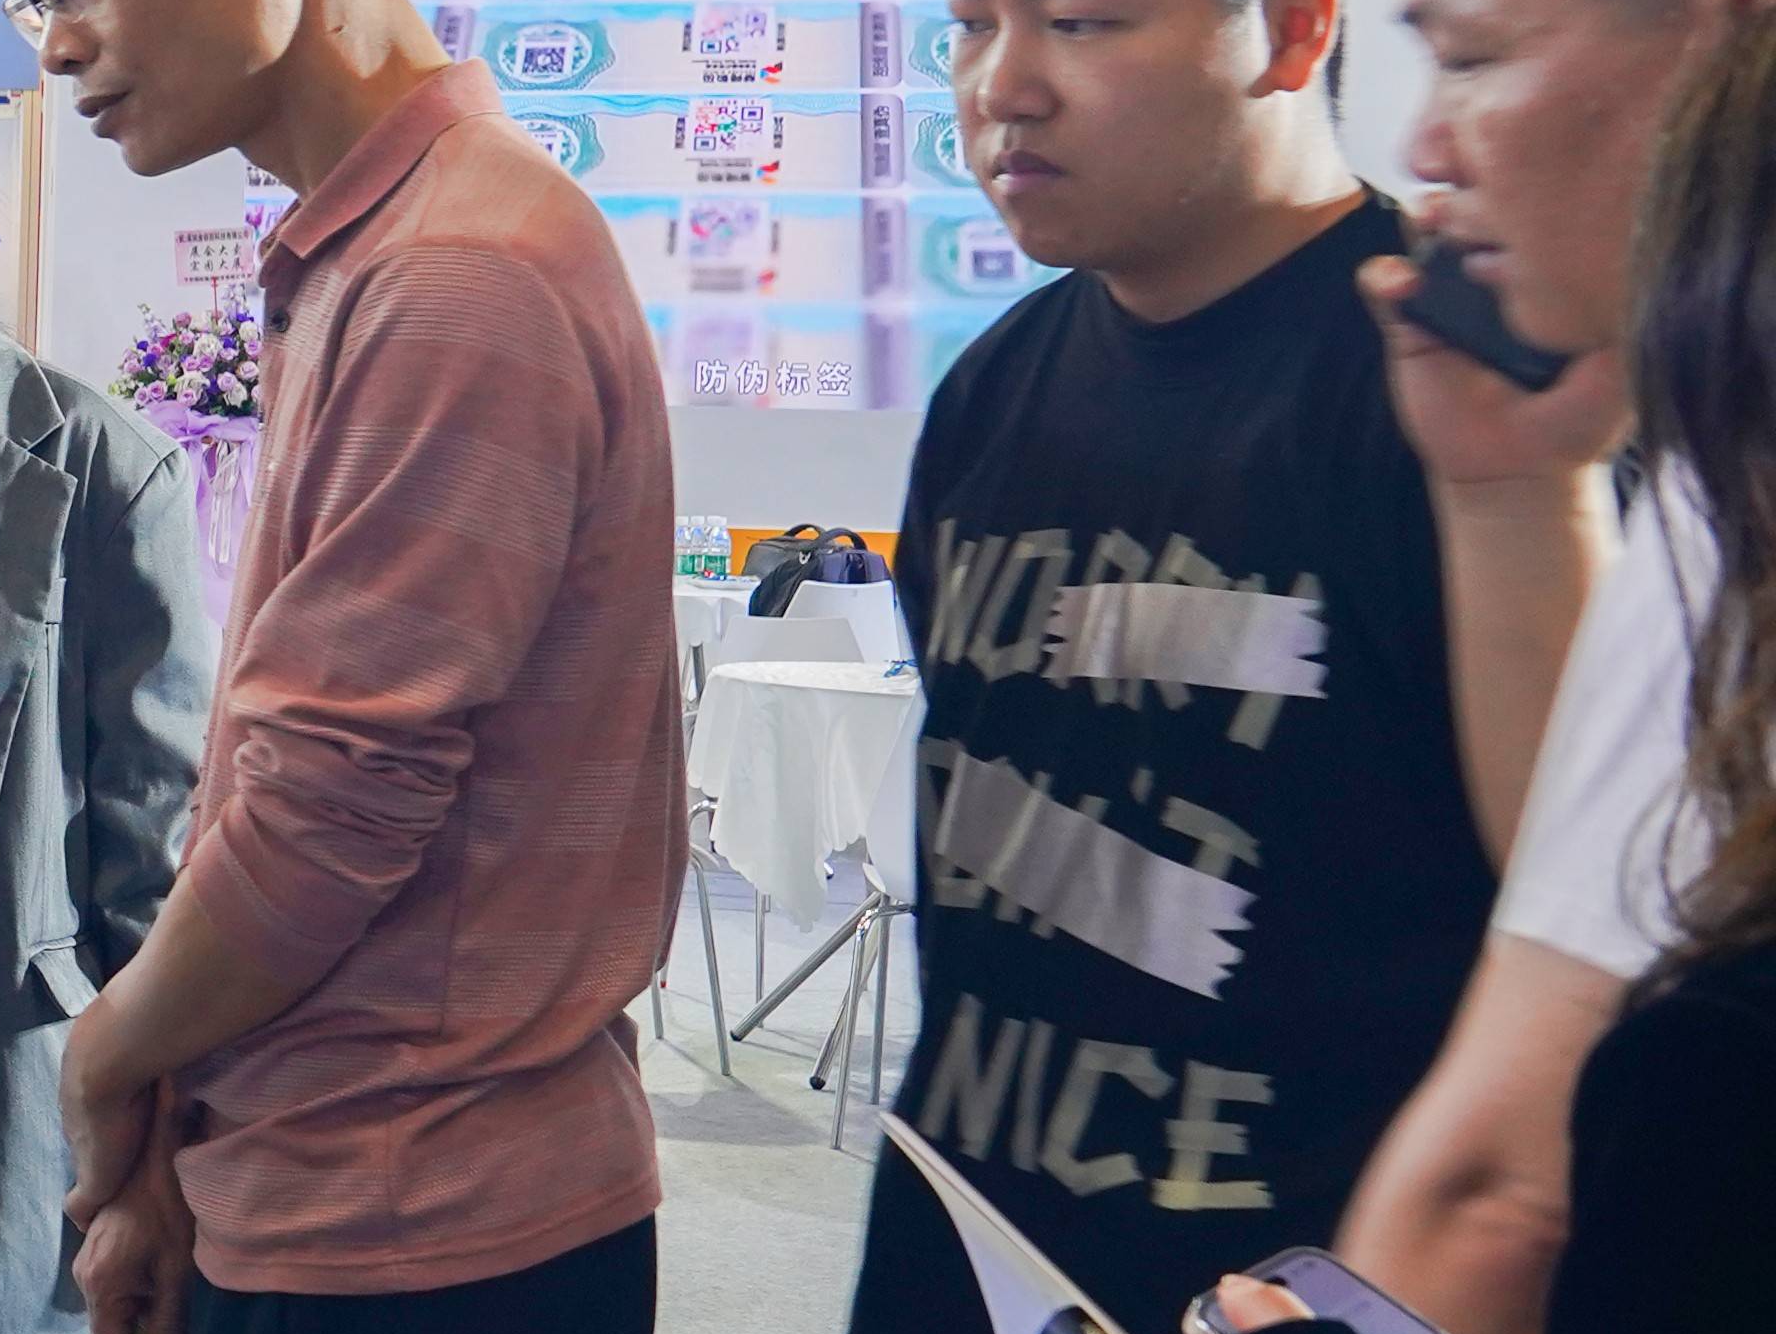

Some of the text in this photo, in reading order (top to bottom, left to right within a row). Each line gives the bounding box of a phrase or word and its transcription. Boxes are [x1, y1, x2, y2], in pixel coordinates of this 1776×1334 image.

[694, 360, 853, 397] 防伪标签
[917, 991, 1276, 1211] NICE
